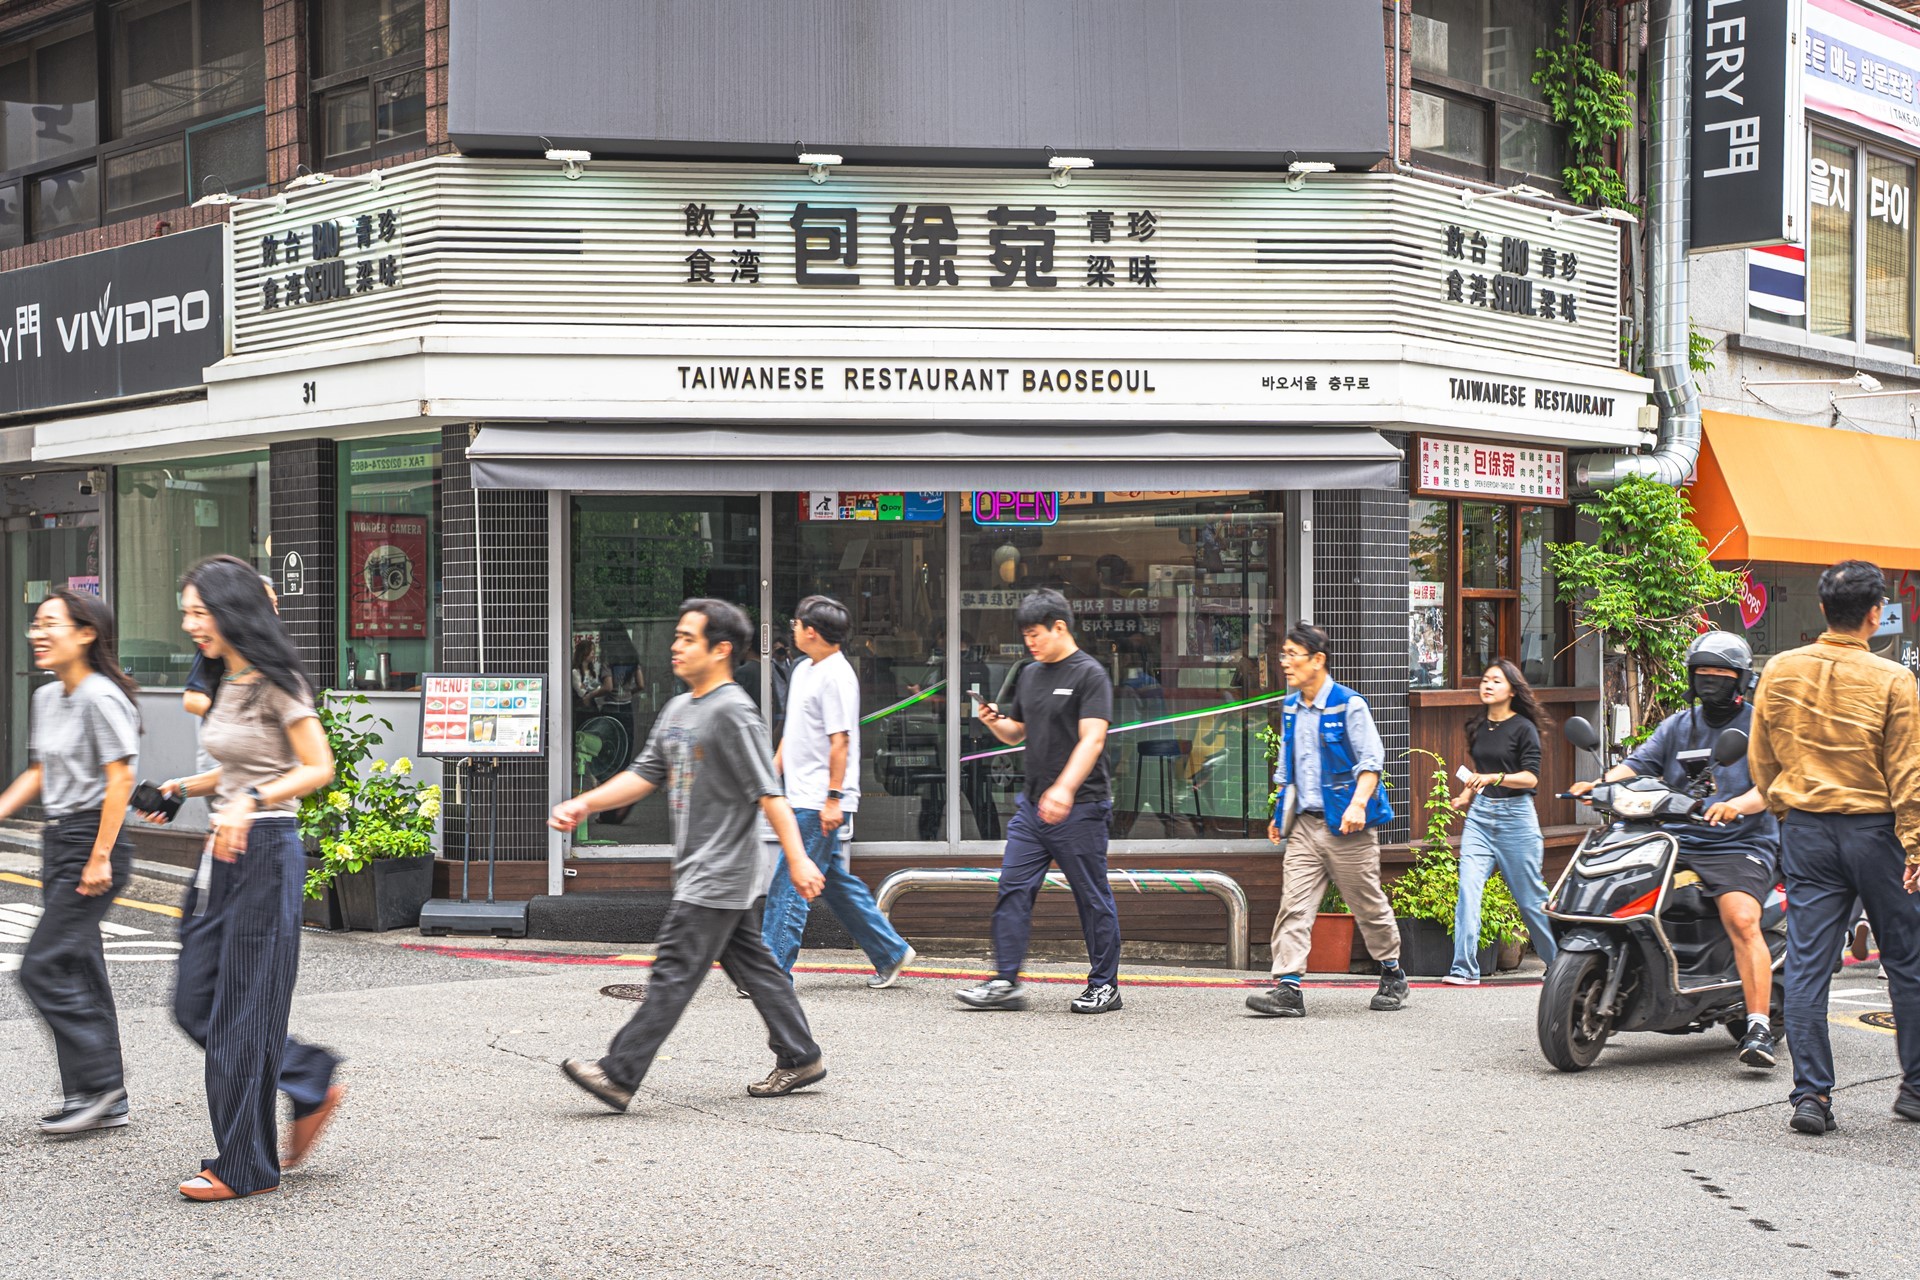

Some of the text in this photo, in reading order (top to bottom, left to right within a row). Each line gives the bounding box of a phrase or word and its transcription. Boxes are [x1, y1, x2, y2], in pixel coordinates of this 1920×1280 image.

[1830, 45, 1857, 84] 메뉴
[1861, 56, 1914, 104] 방문포장
[1811, 158, 1910, 230] 을지 타이
[312, 219, 341, 261] BAO
[1502, 236, 1529, 276] BAO
[304, 259, 351, 303] SEOUL
[1492, 273, 1537, 316] SEOUL
[56, 289, 210, 354] VIVIDRO
[302, 380, 316, 404] 31
[678, 366, 1156, 393] TAIWANESE RESTAURANT BAOSEOUL
[1261, 376, 1371, 391] 바오서울 충무로
[1449, 377, 1616, 418] TAIWANESE RESTAURANT
[977, 491, 1055, 521] OPEN
[353, 522, 422, 535] WONDER CAMERA
[1901, 646, 1920, 671] 샐러
[434, 678, 463, 693] MENU
